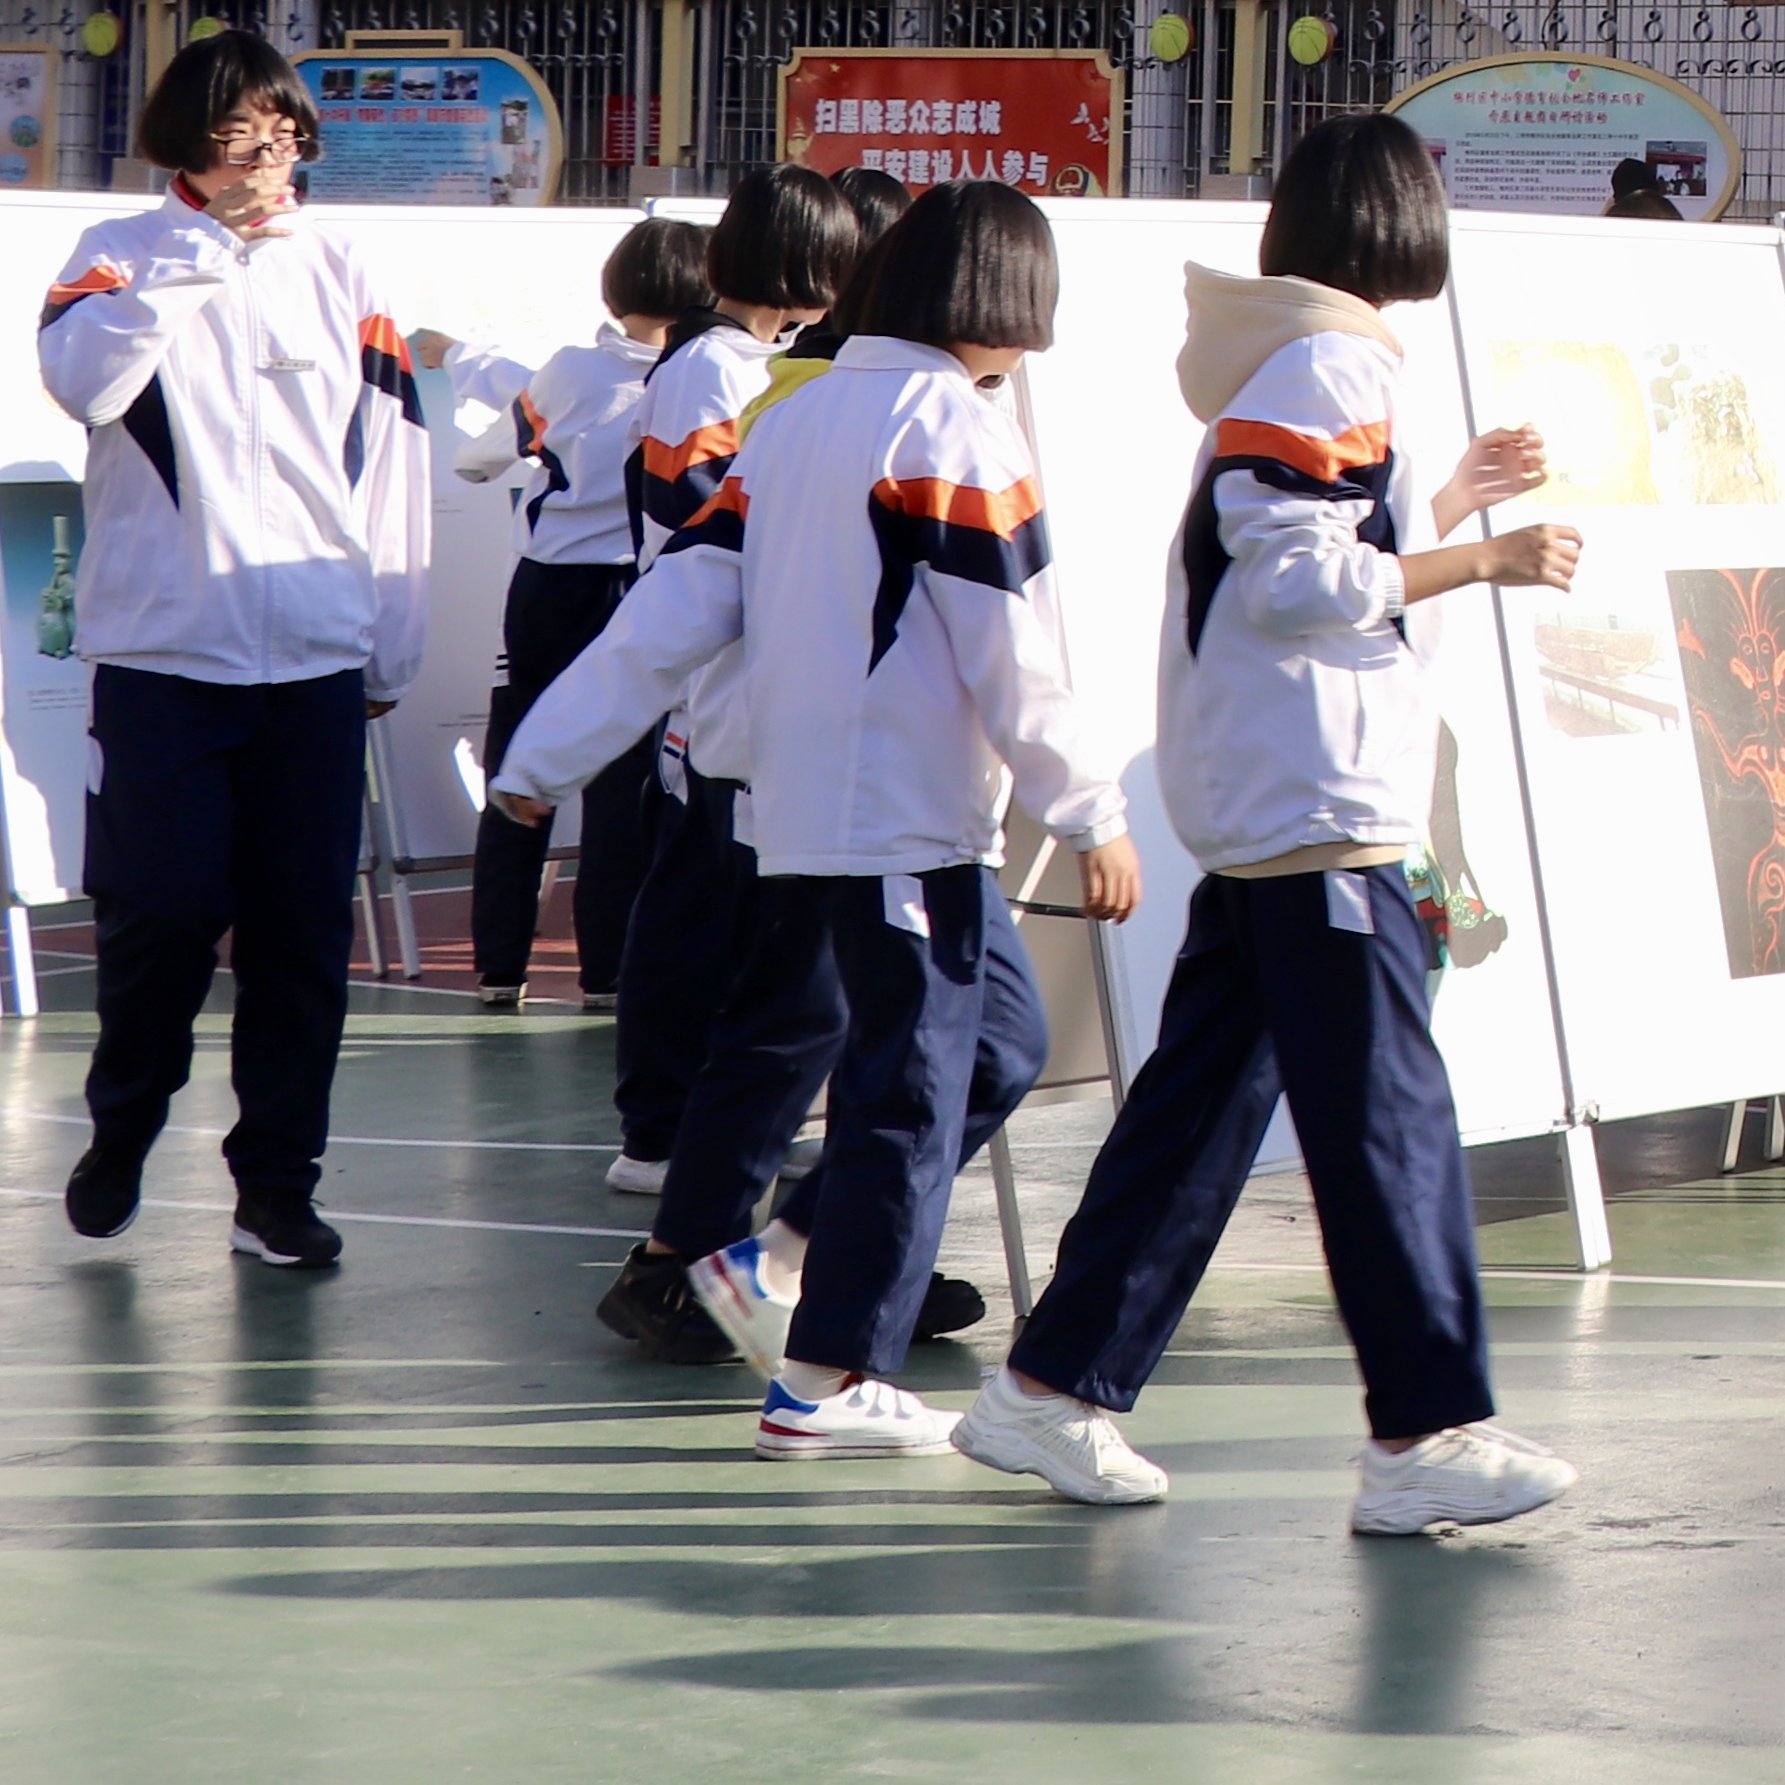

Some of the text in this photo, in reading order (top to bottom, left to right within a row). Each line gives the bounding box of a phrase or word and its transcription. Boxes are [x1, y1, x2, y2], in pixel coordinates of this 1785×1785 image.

[815, 99, 1002, 136] 扫黑除恶众志成城
[862, 150, 1050, 187] 平安建设人人参与
